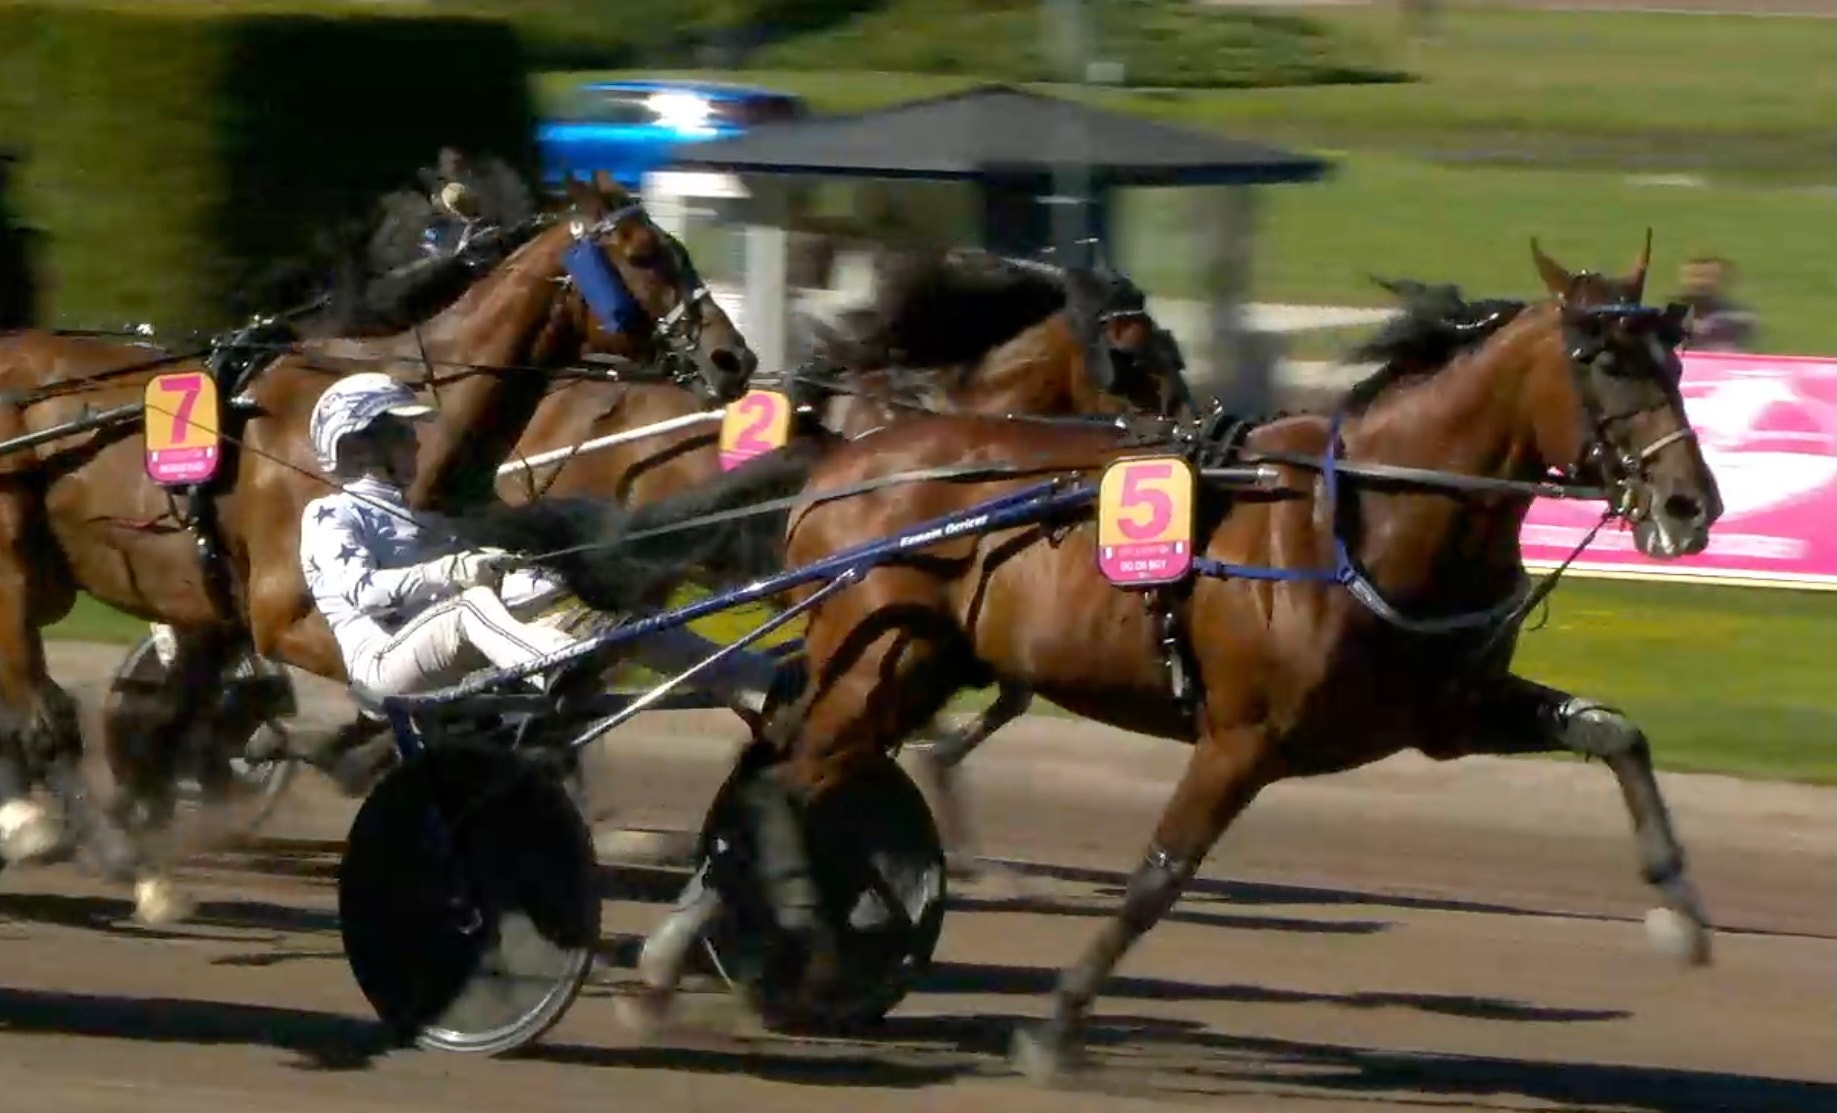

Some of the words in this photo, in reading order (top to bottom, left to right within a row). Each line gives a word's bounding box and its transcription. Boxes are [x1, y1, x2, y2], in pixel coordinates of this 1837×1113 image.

[160, 376, 201, 444] 7
[736, 395, 775, 451] 2
[1117, 465, 1173, 540] 5
